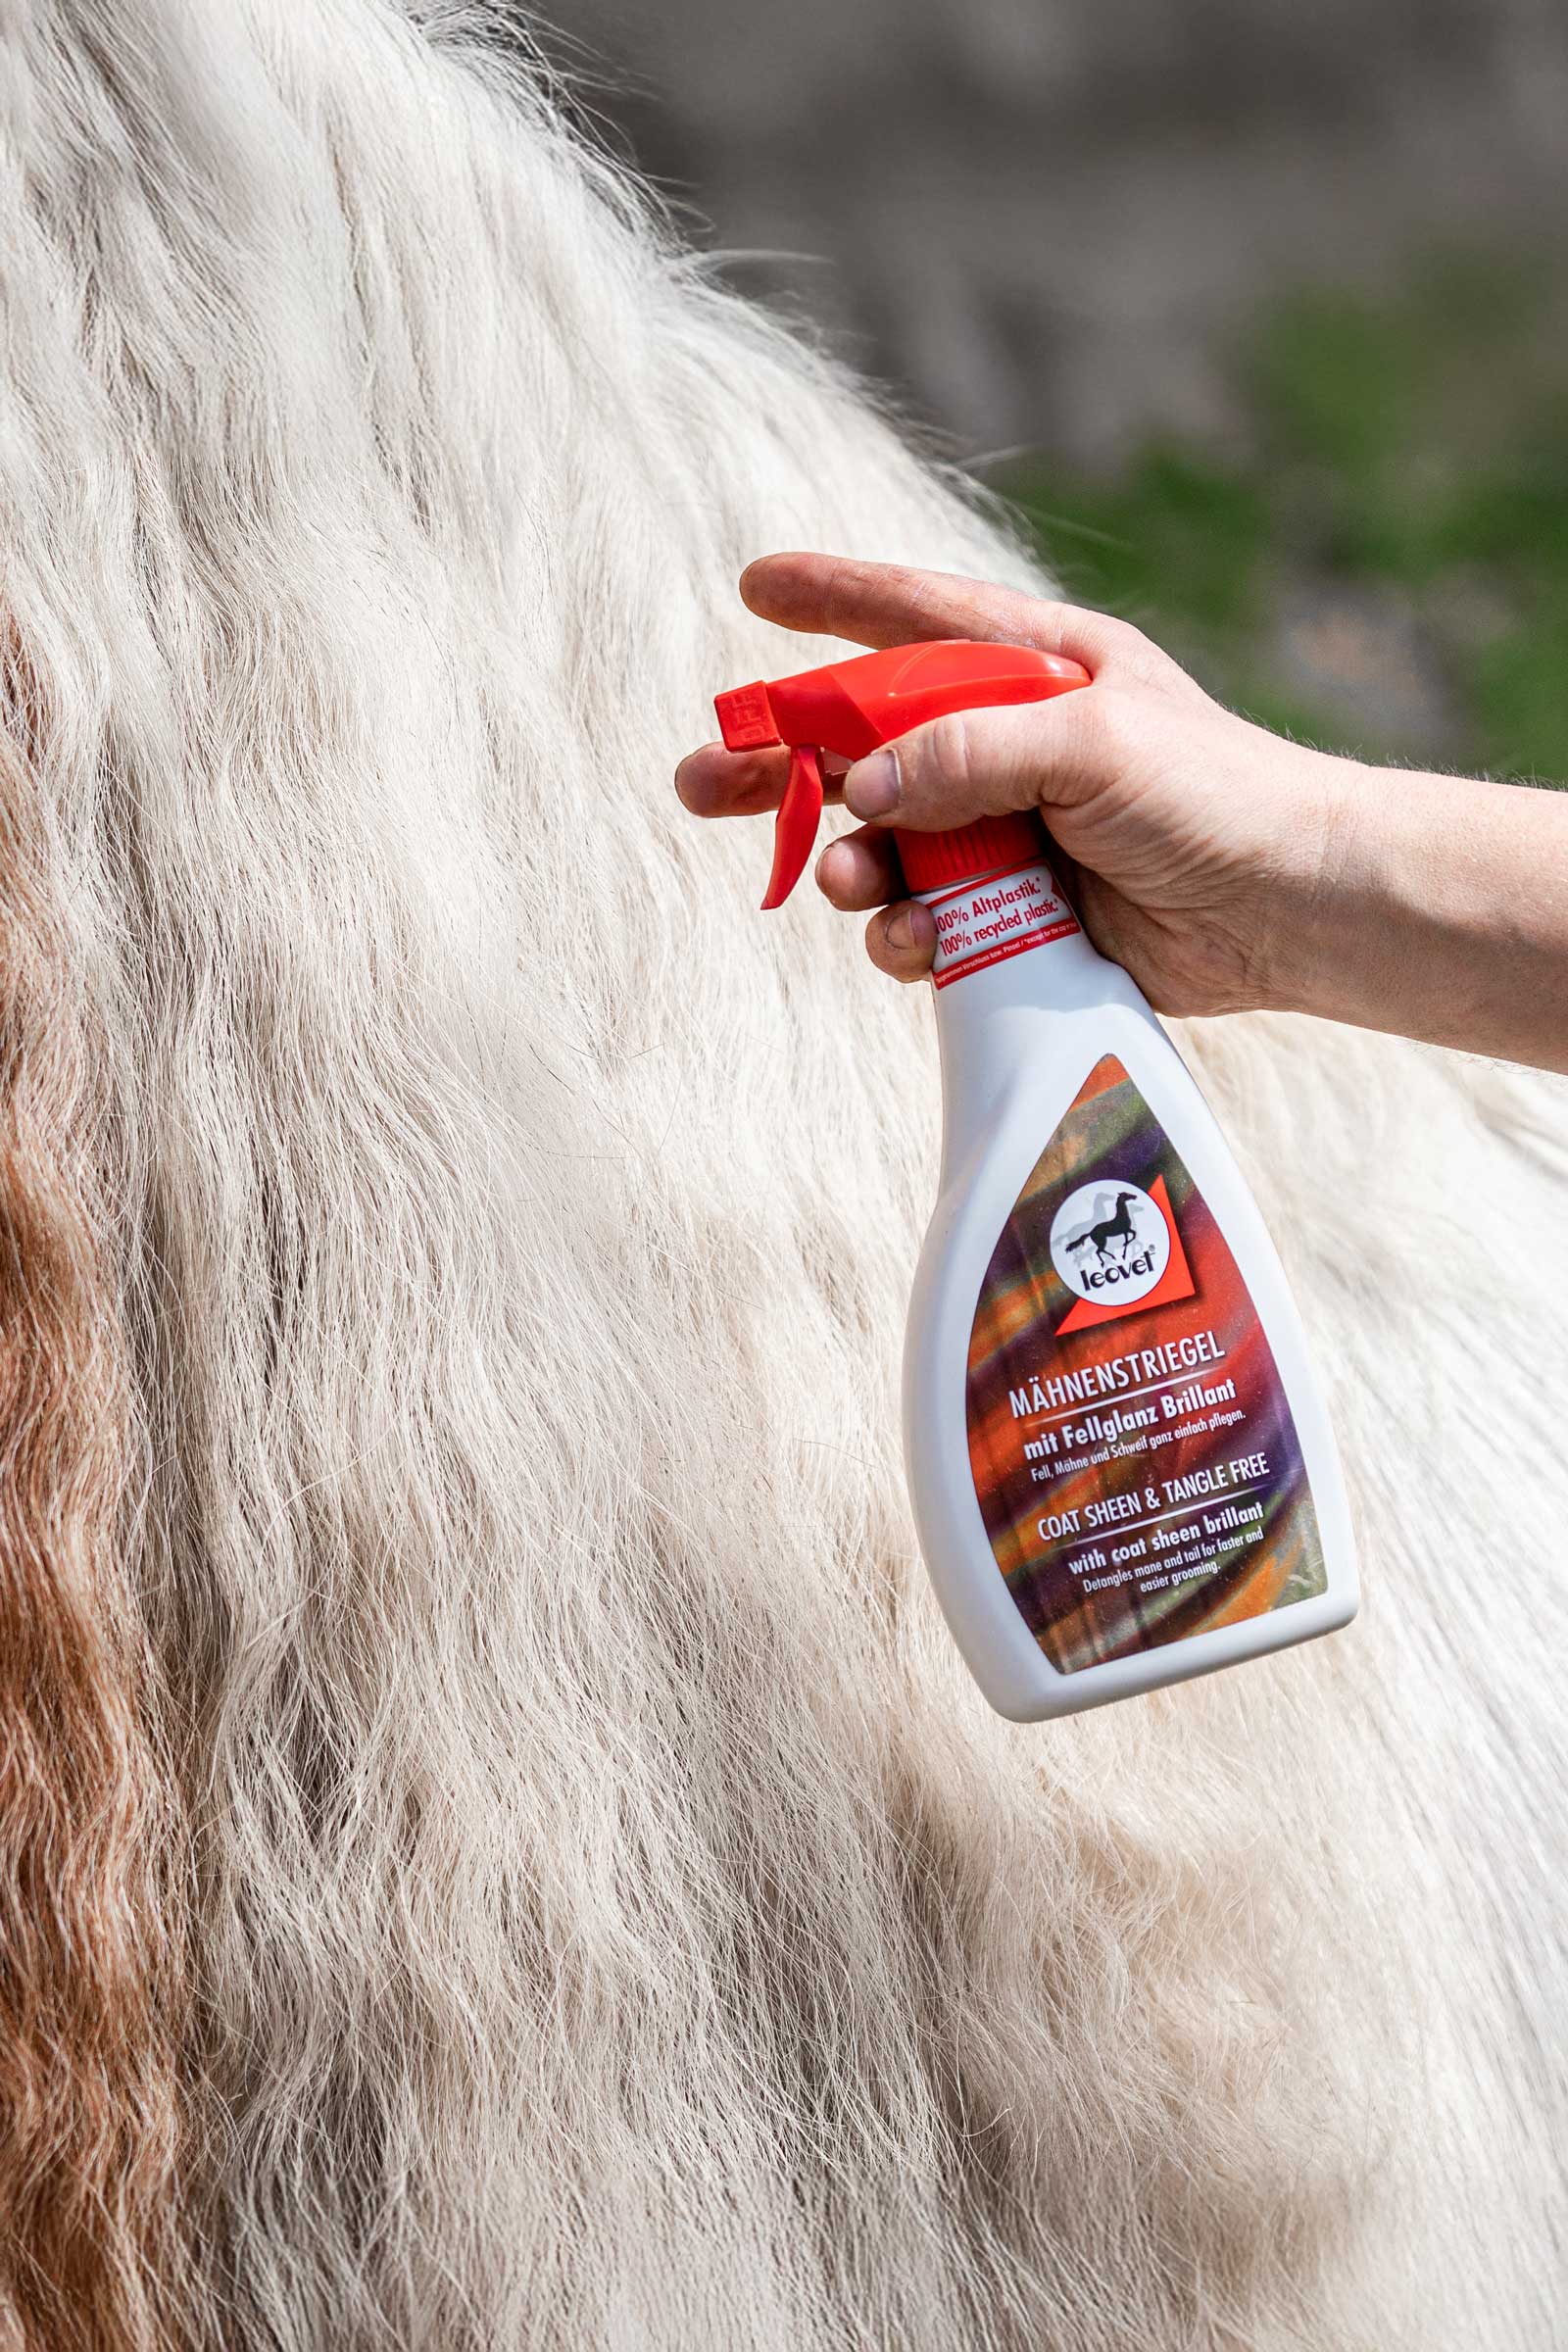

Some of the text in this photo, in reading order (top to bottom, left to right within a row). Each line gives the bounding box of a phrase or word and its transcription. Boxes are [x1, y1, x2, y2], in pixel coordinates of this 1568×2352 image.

[940, 930, 972, 956] 100%
[974, 908, 1022, 942] recycled
[1008, 1330, 1225, 1419] MÄHNENSTRIEGEL
[1023, 1378, 1237, 1460] mit Fellglanz Brillant
[1031, 1408, 1247, 1483] Fell, Mähne und Schweif ganz einfach pflegen.
[1037, 1451, 1270, 1542] COAT SHEEN & TANGLE FREE
[1068, 1500, 1264, 1576] with coat sheen brillant
[1082, 1526, 1264, 1593] Detangles mane and tail for faster and
[1140, 1560, 1221, 1593] easier grooming.
